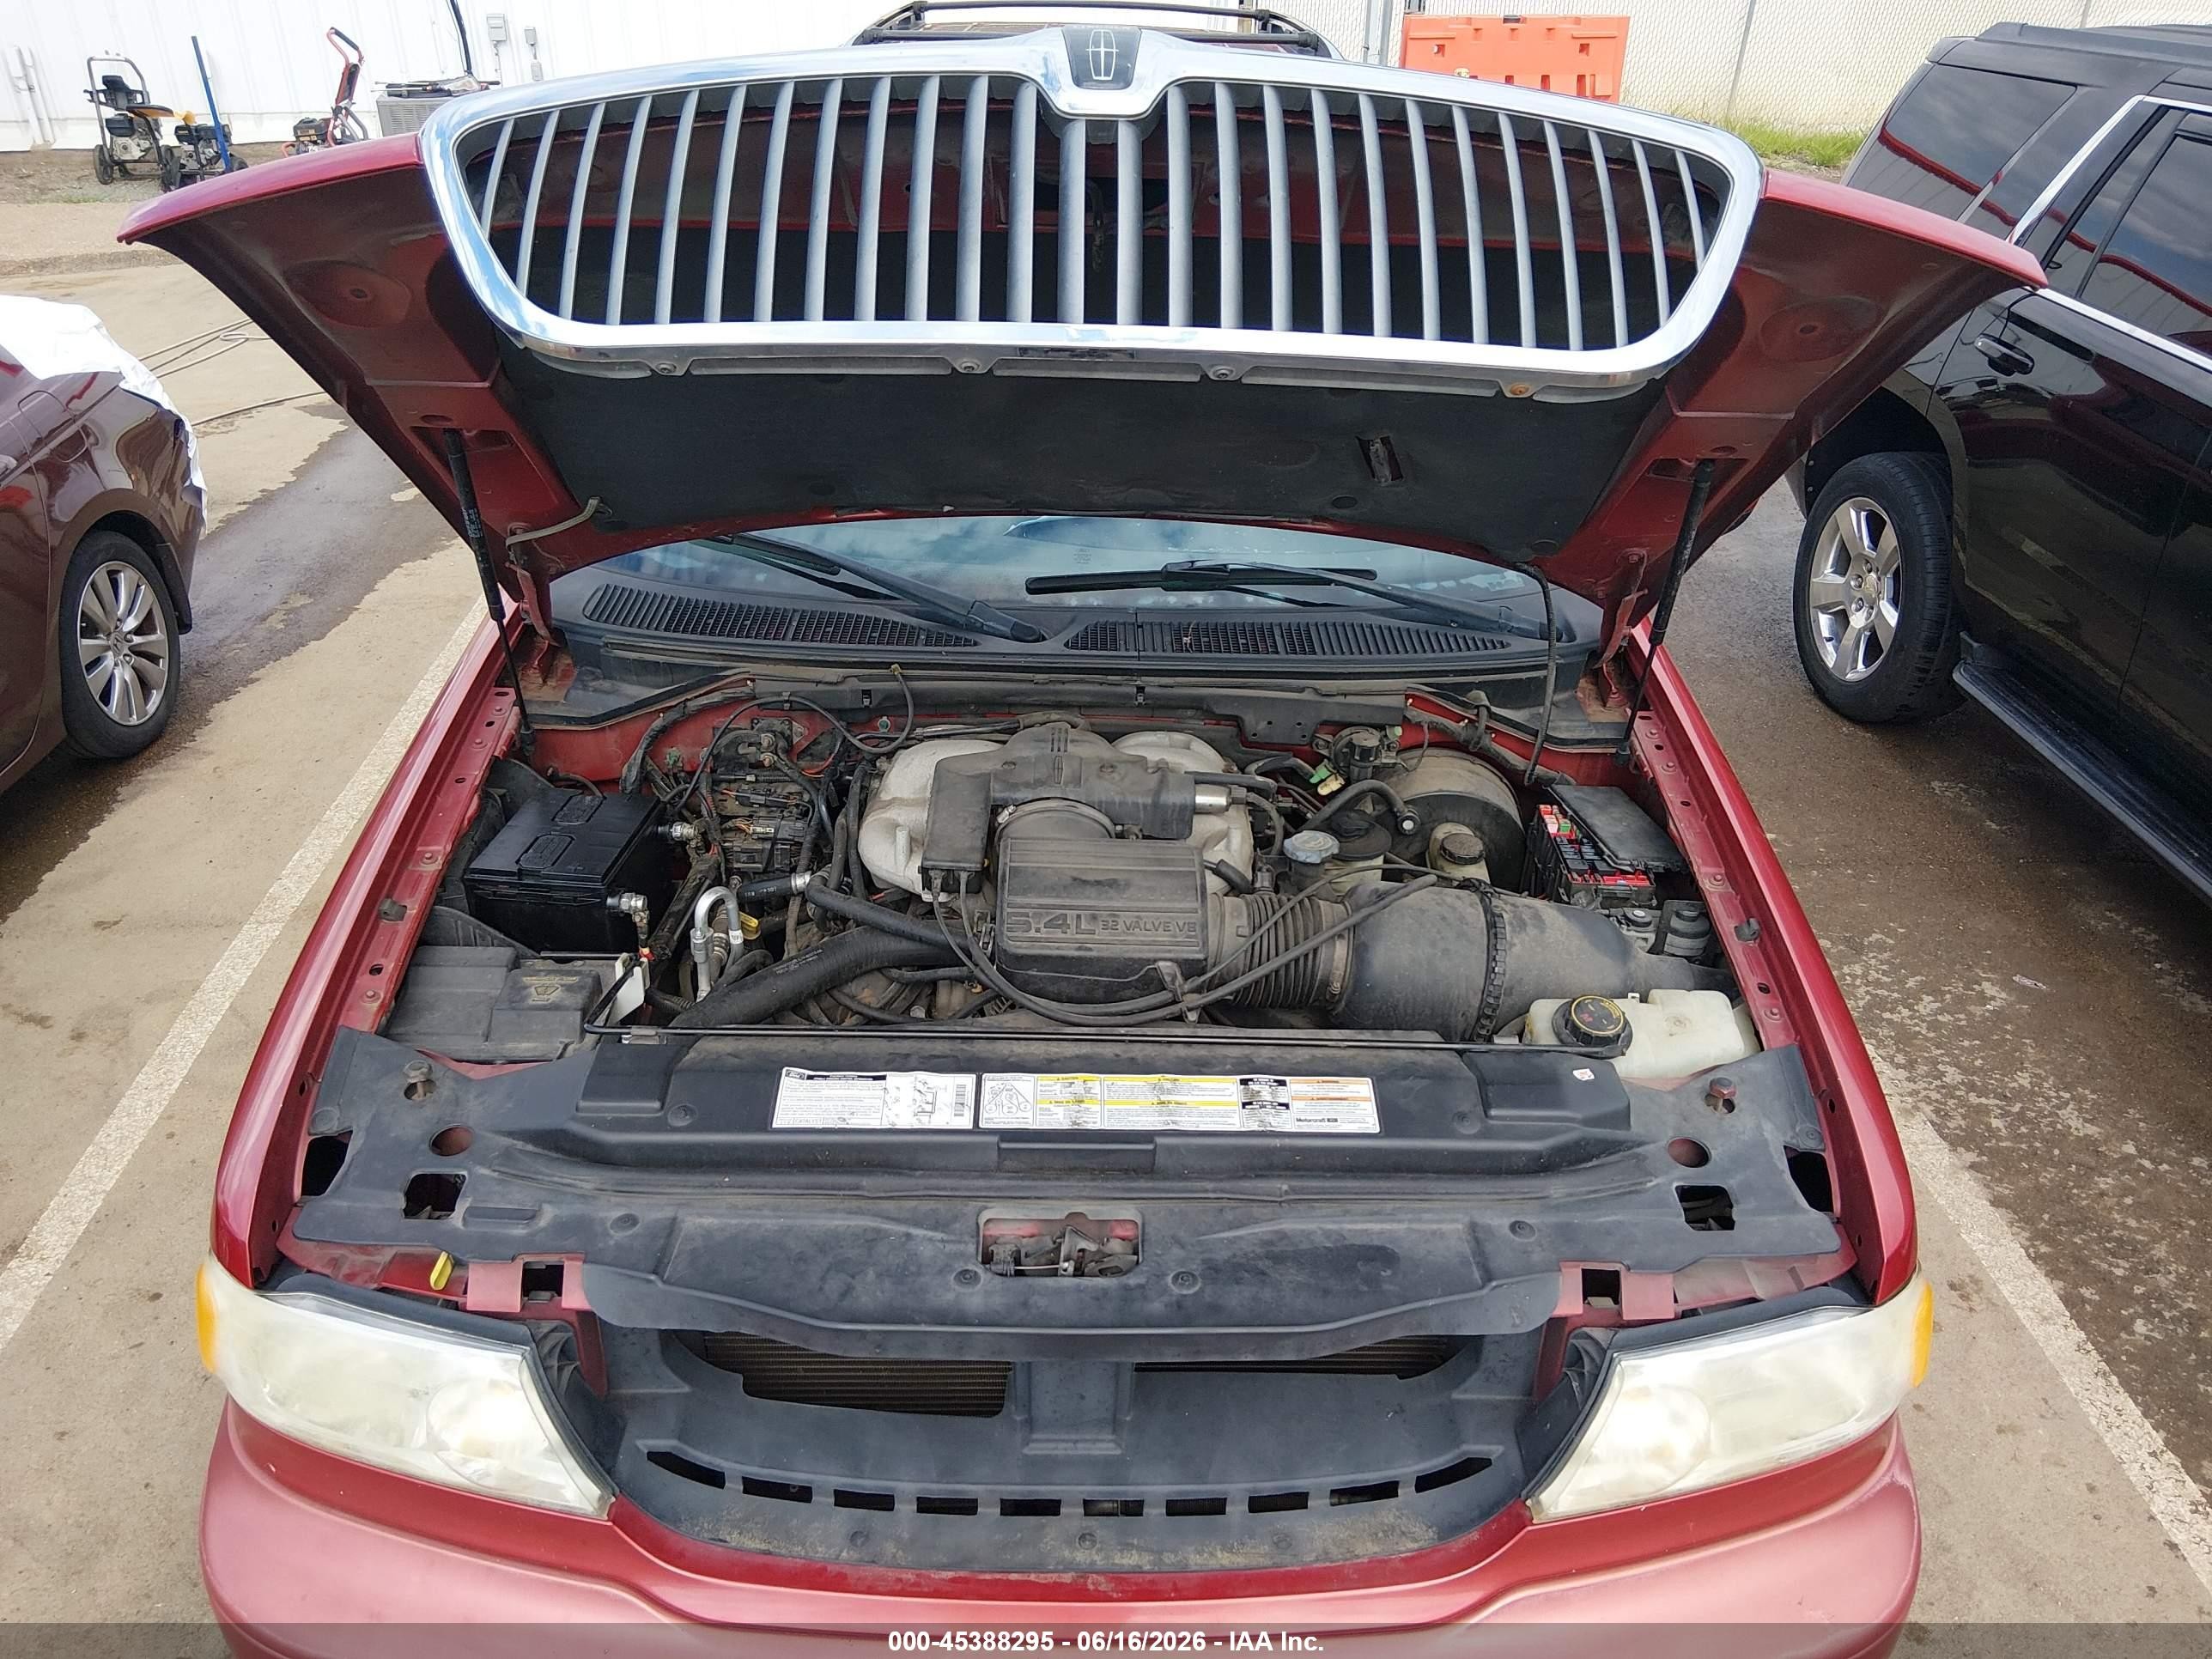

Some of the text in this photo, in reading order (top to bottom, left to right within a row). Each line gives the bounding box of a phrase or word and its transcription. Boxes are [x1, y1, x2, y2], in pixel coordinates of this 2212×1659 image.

[1006, 911, 1197, 935] 5.4L 32 VALVE V8
